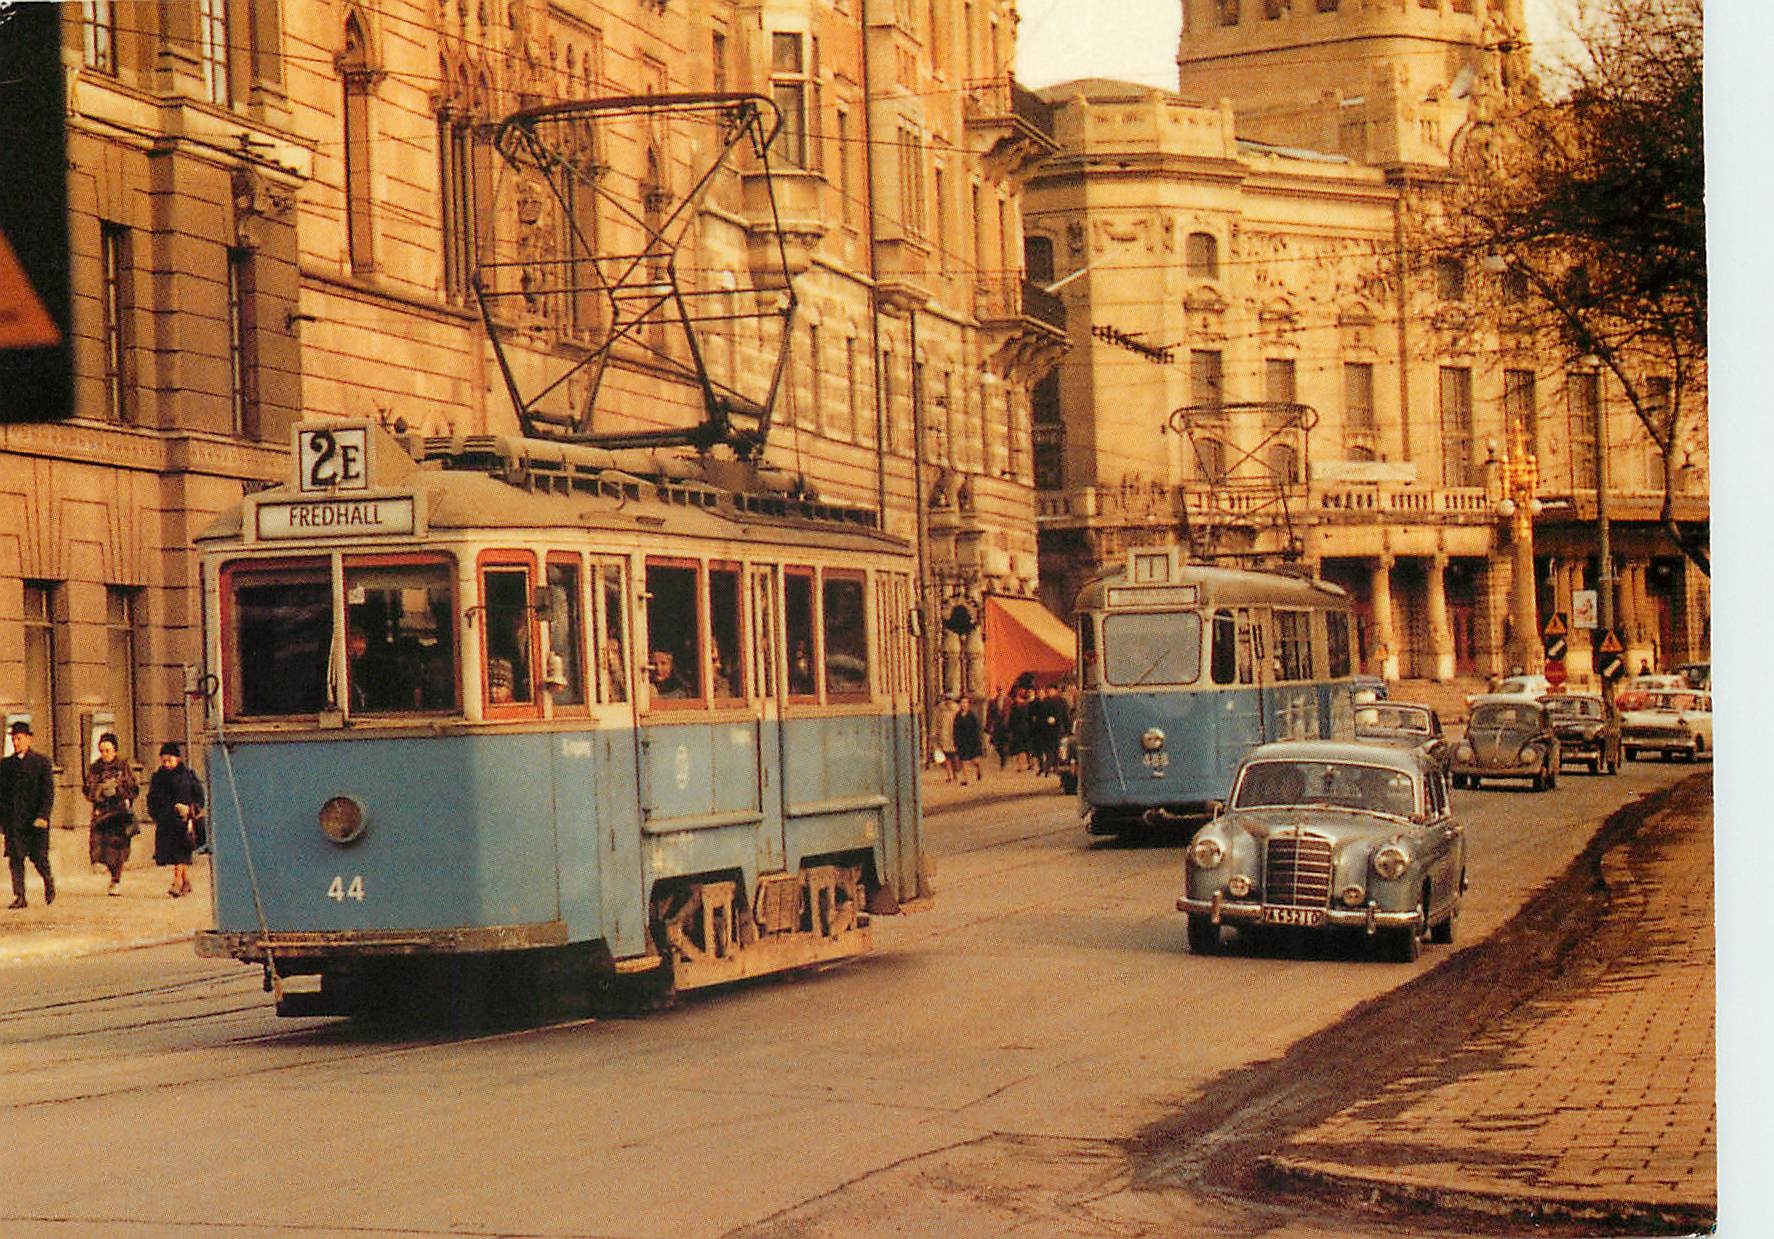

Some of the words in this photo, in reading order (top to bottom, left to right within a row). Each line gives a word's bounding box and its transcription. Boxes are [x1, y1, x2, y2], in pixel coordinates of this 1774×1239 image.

[310, 430, 360, 486] 2E
[289, 504, 382, 527] FREDHALL
[327, 875, 367, 902] 44
